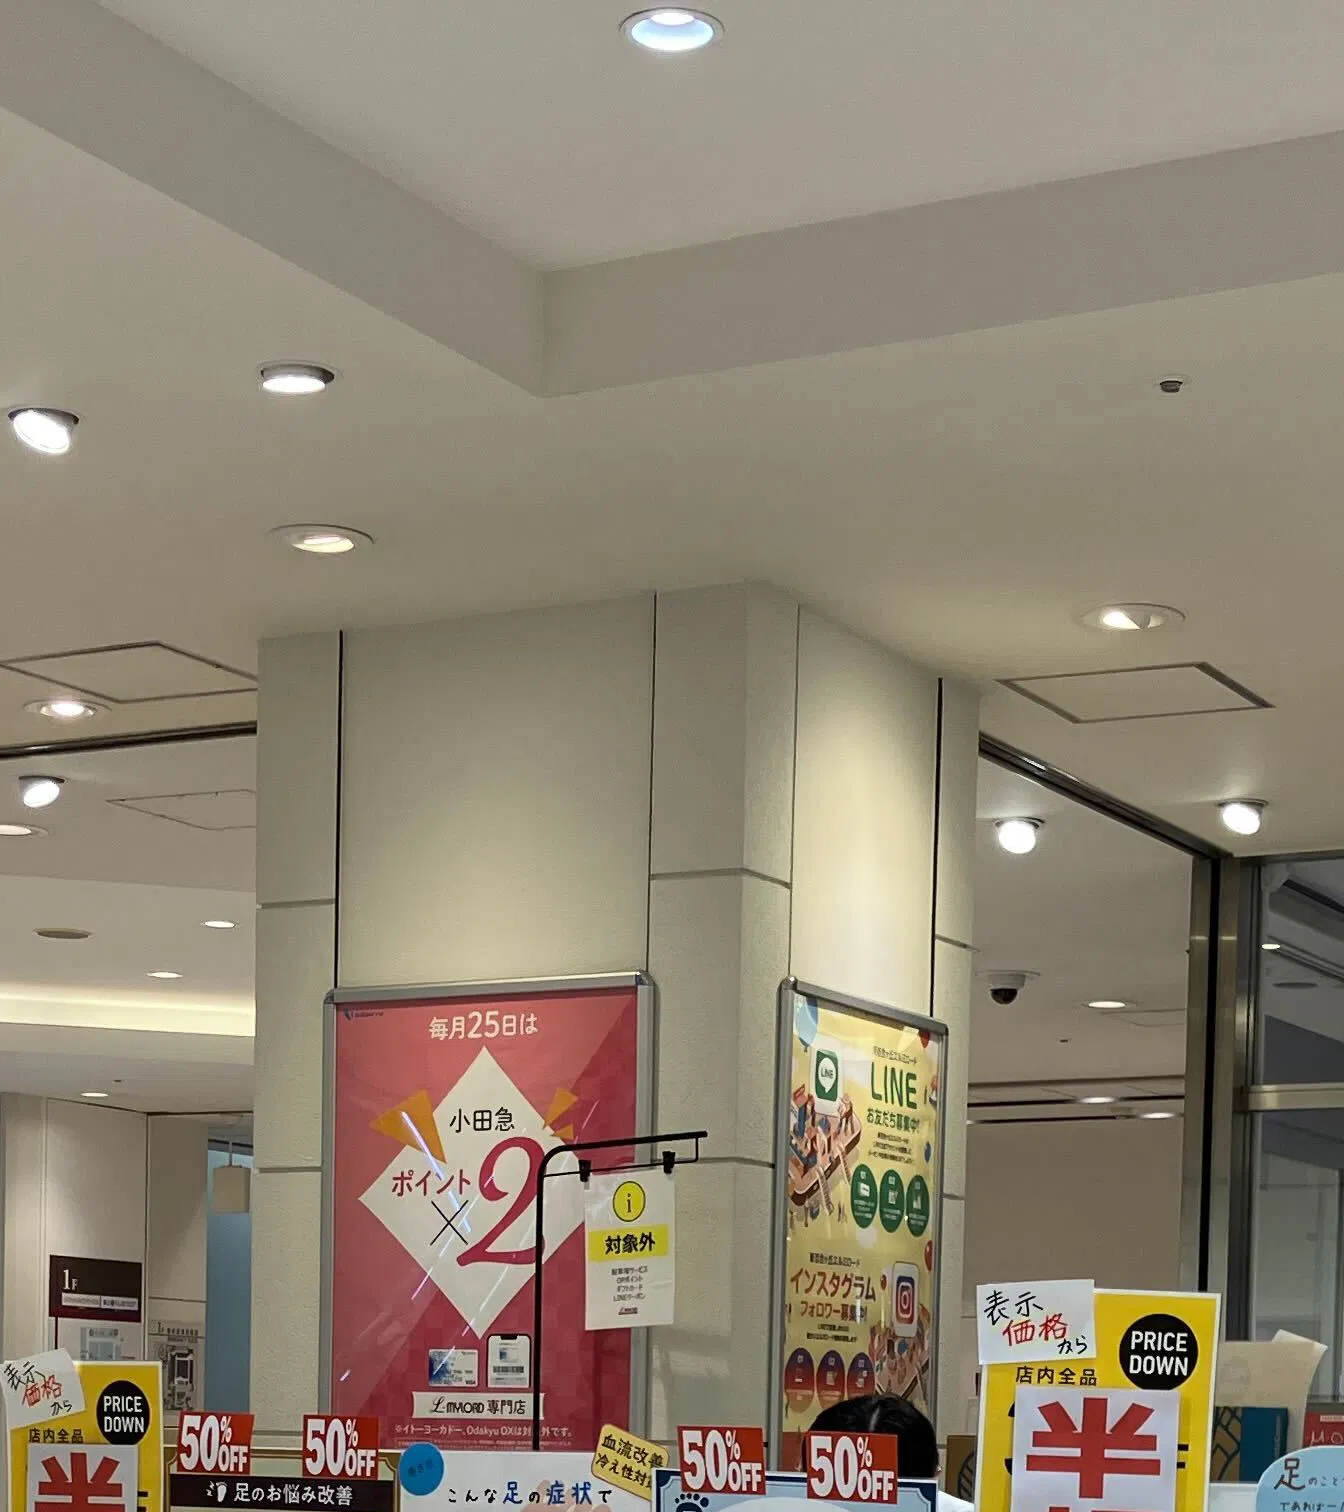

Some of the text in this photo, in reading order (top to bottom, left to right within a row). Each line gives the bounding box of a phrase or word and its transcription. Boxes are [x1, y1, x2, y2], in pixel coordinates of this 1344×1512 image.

[429, 1010, 538, 1041] 毎月25日は
[821, 1067, 834, 1079] LINE
[871, 1062, 918, 1109] LINE
[449, 1106, 515, 1133] 小田急
[391, 1168, 471, 1197] ポイント
[605, 1232, 656, 1254] 対象外
[63, 1269, 79, 1290] 1F
[790, 1267, 877, 1302] インスタグラム
[984, 1289, 1044, 1326] 表示
[1002, 1313, 1069, 1347] 価格
[1130, 1330, 1189, 1353] PRICE
[1057, 1335, 1088, 1355] から
[2, 1362, 46, 1391] 表示
[1015, 1366, 1098, 1386] 店内全品
[1128, 1354, 1189, 1377] DOWN
[21, 1374, 64, 1408] 価格
[50, 1400, 74, 1417] から
[103, 1395, 143, 1414] PRICE
[487, 1399, 526, 1416] 専門店
[29, 1427, 85, 1444] 店内全品
[103, 1416, 145, 1434] DOWN
[601, 1434, 663, 1471] 血流改善
[234, 1482, 353, 1507] 足のお悩み改善
[448, 1481, 614, 1505] こんな足の症状で
